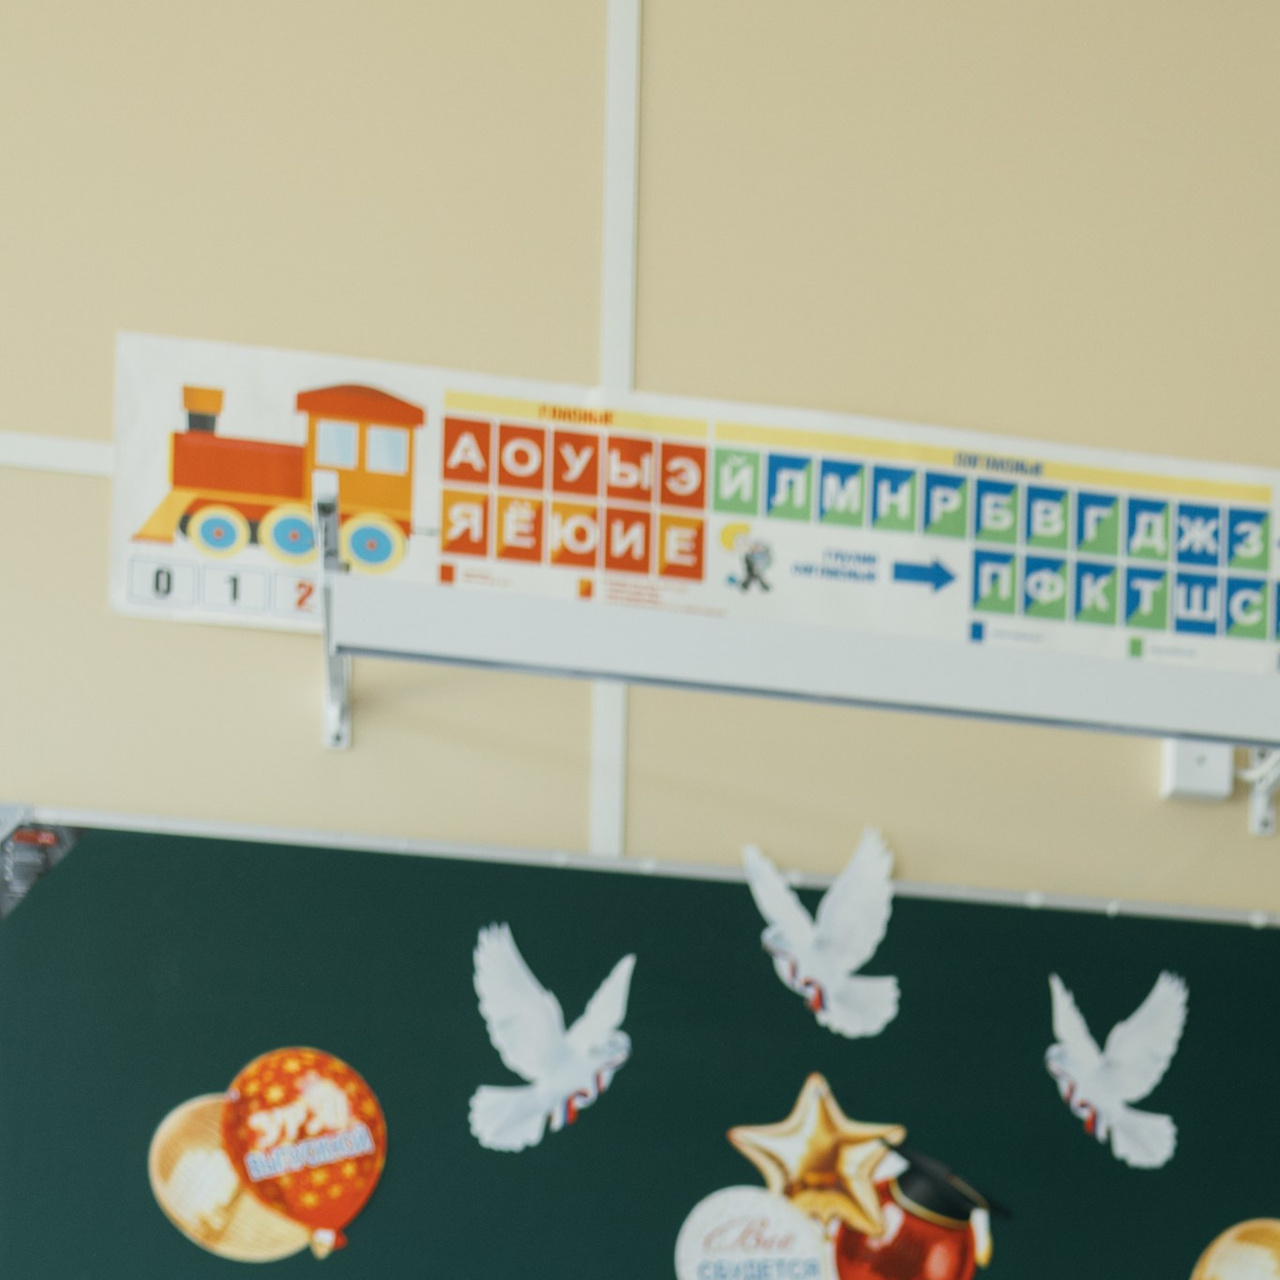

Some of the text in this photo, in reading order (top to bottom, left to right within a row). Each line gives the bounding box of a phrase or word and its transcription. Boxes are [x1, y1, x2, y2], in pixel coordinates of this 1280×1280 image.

[446, 431, 701, 496] А О У Ы Э
[446, 500, 697, 566] Я Ё Ю И Е
[720, 454, 1264, 559] Й Л М Н Р Б В Г Д Ж З
[154, 569, 315, 611] 0 1 2
[979, 561, 1010, 601] П
[1025, 569, 1065, 605] Ф
[1080, 572, 1109, 612] К
[1130, 578, 1163, 616] Т
[1177, 585, 1218, 622] Ш
[1229, 589, 1263, 626] С
